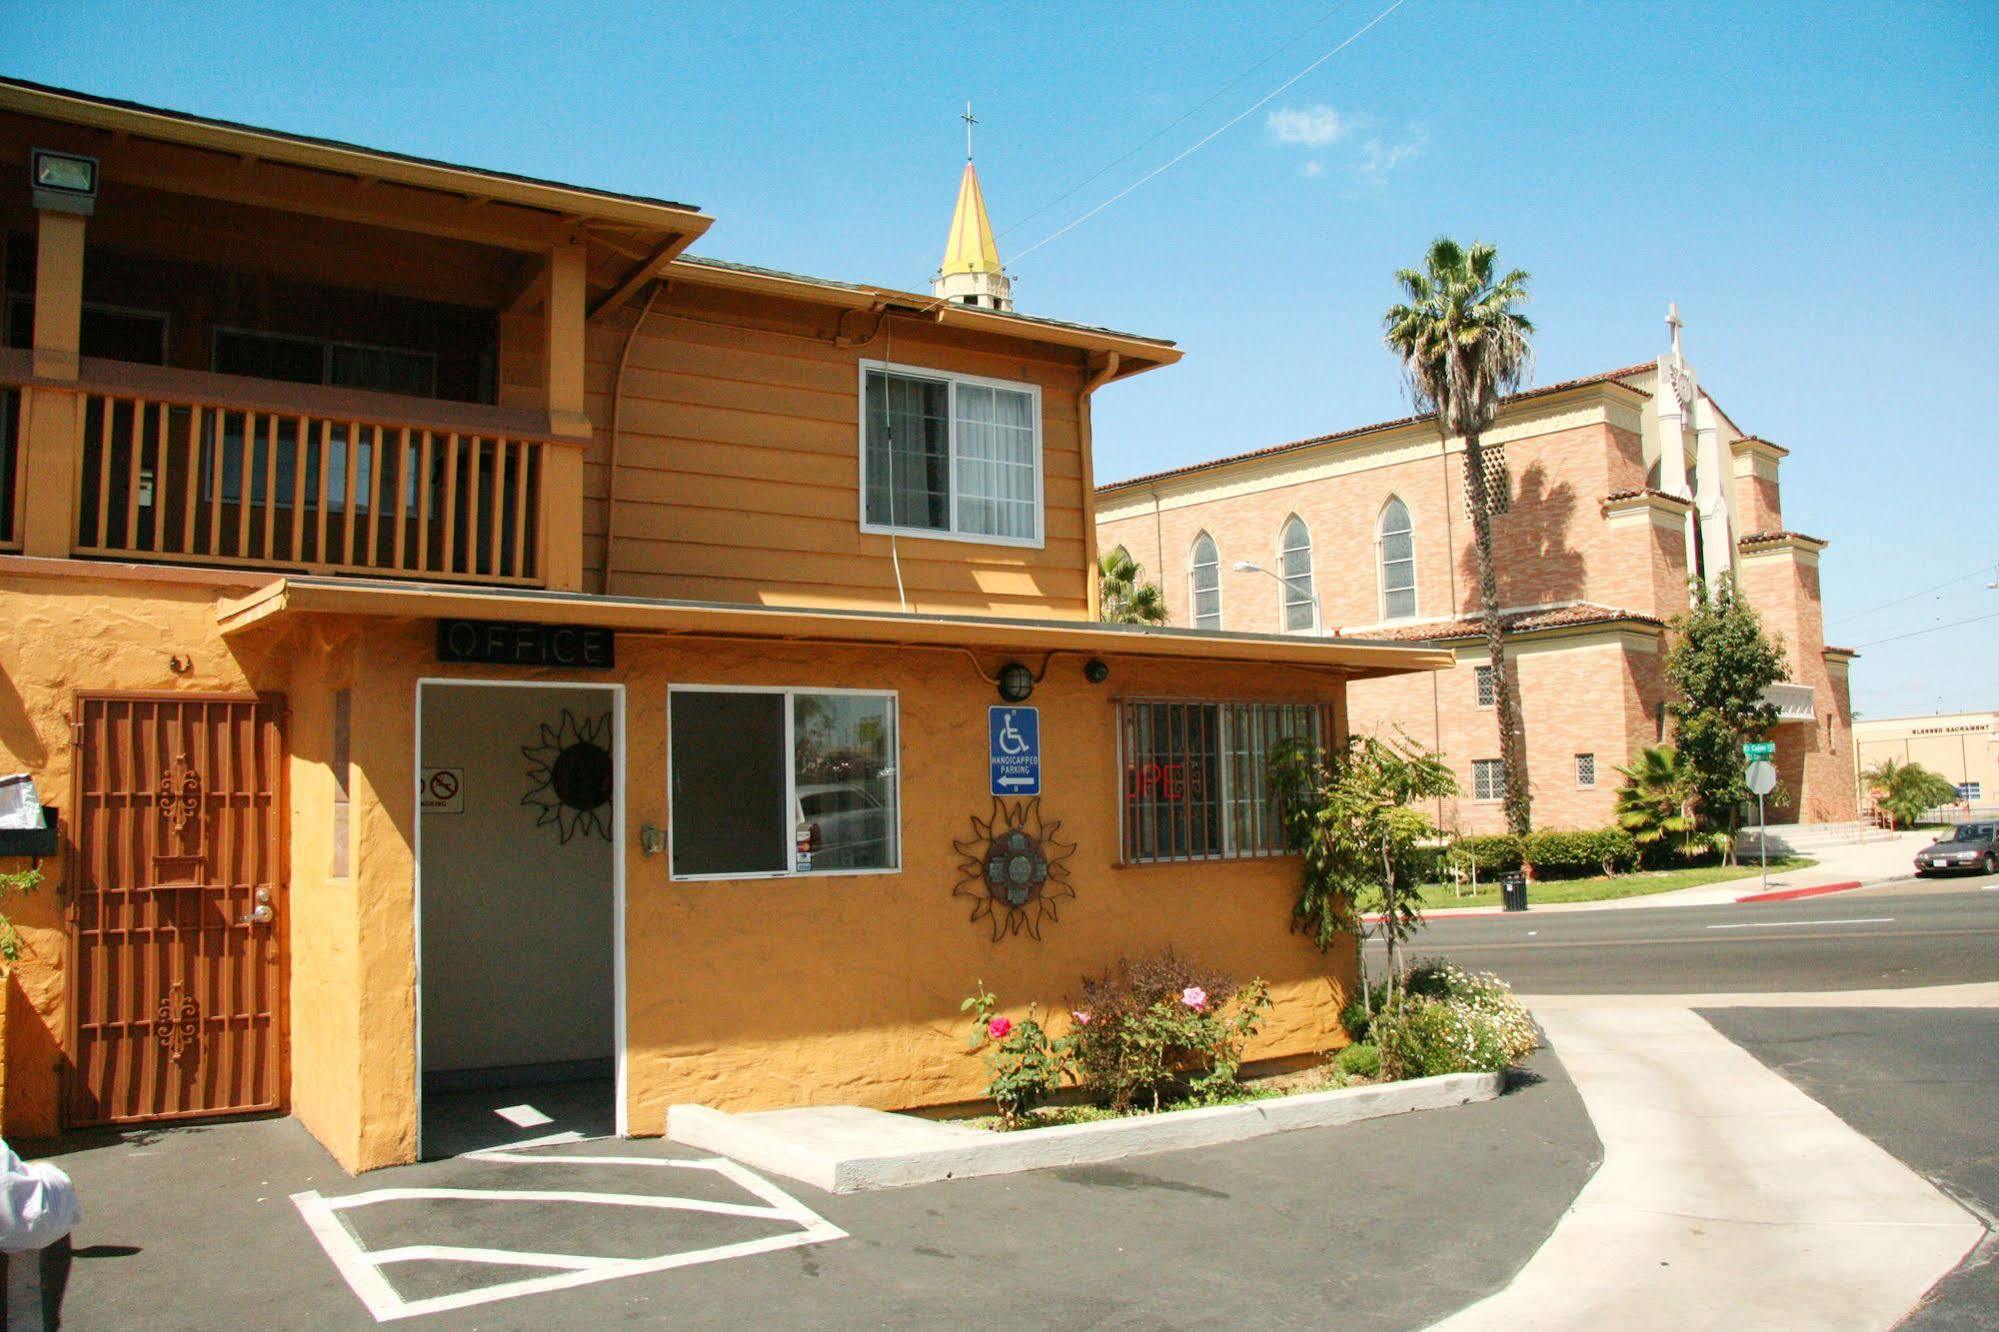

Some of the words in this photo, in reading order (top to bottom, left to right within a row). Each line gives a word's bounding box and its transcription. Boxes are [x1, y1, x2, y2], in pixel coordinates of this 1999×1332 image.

[449, 623, 602, 663] OFFICE
[992, 756, 1038, 765] HANDICAPPED
[1000, 765, 1030, 774] PARKING
[1124, 763, 1188, 800] OPE
